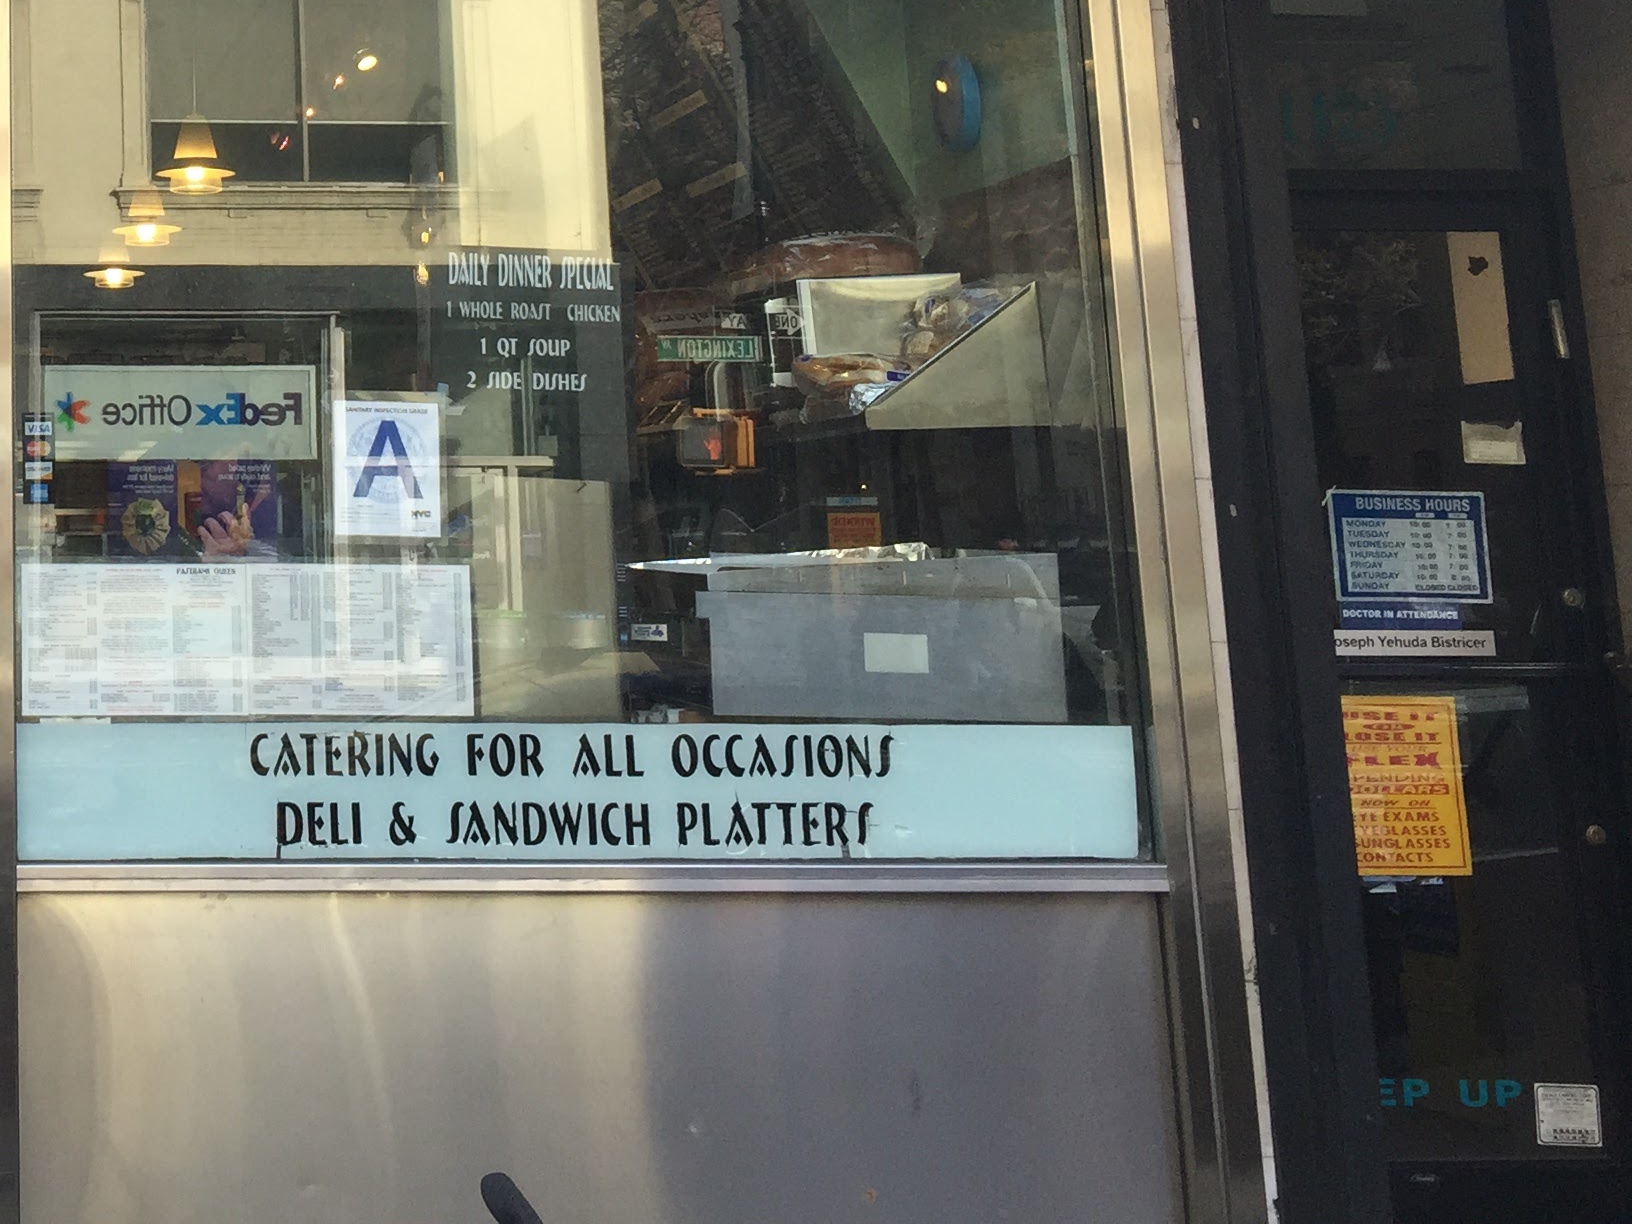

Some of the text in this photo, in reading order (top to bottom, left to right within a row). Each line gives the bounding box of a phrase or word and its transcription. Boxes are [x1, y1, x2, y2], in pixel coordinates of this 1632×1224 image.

[448, 251, 615, 291] DAILY DINNER SPECIAL
[459, 301, 504, 319] WHOLE
[510, 302, 552, 320] ROAST
[567, 304, 620, 323] CHICKEN
[496, 338, 519, 358] QT
[527, 338, 571, 357] SOUP
[466, 371, 588, 392] 2 SIDE DISHES
[353, 420, 424, 499] A
[1355, 497, 1471, 512] BUSINESS HOURS
[1346, 520, 1386, 528] MONDAY
[1347, 530, 1390, 538] TUESDAY
[1350, 551, 1399, 559] THURSDAY
[1351, 582, 1390, 590] SUNDAY
[1342, 610, 1459, 620] DOCTOR IN ATTENDANCE
[1335, 636, 1487, 650] oseph Yehuda Bistricer
[1414, 732, 1440, 742] IT
[249, 732, 895, 778] CATERING FOR ALL OCCASIONS
[1361, 799, 1400, 807] NOW
[276, 801, 874, 847] DELI & SANDWICH PLATTERS
[1383, 812, 1440, 822] EXAMS
[1354, 826, 1447, 837] YEGLASSES
[1459, 1080, 1522, 1108] UP
